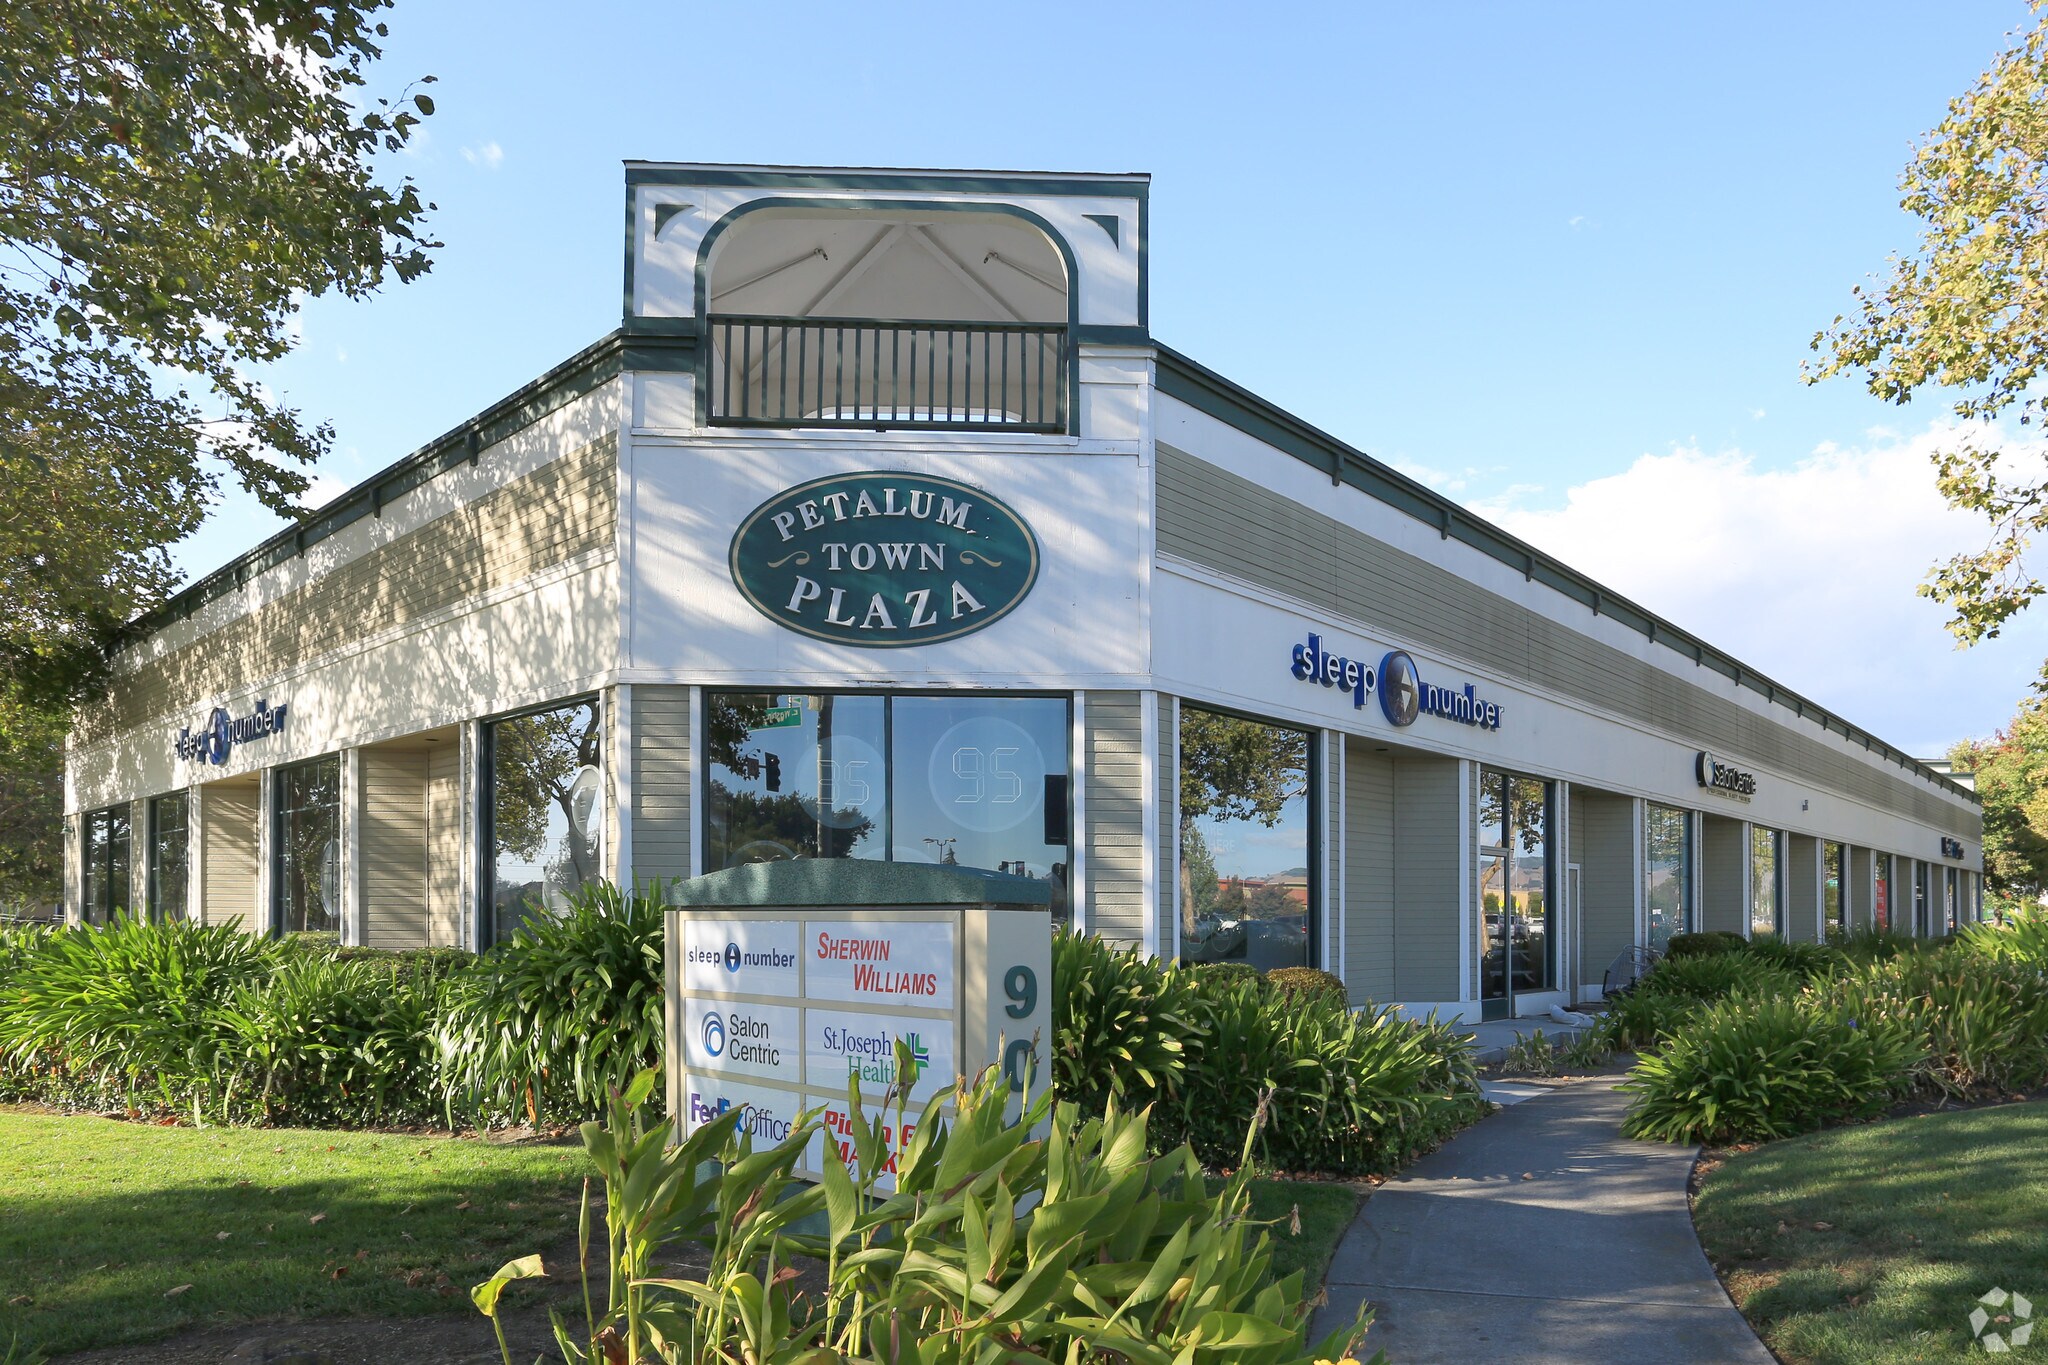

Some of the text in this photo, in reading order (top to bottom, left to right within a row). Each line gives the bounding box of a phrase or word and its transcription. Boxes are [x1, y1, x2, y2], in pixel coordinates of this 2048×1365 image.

[770, 487, 973, 543] PETALUM
[822, 542, 946, 572] TOWN
[785, 575, 986, 630] PLAZA
[1293, 632, 1504, 731] sleep number
[227, 699, 287, 745] number
[952, 746, 1022, 803] 95
[688, 945, 795, 968] sleep number
[817, 932, 890, 961] SHERWIN
[854, 963, 937, 996] WILLIAMS
[729, 1013, 769, 1040] Salon
[729, 1038, 780, 1066] Centric
[744, 1106, 793, 1141] Office
